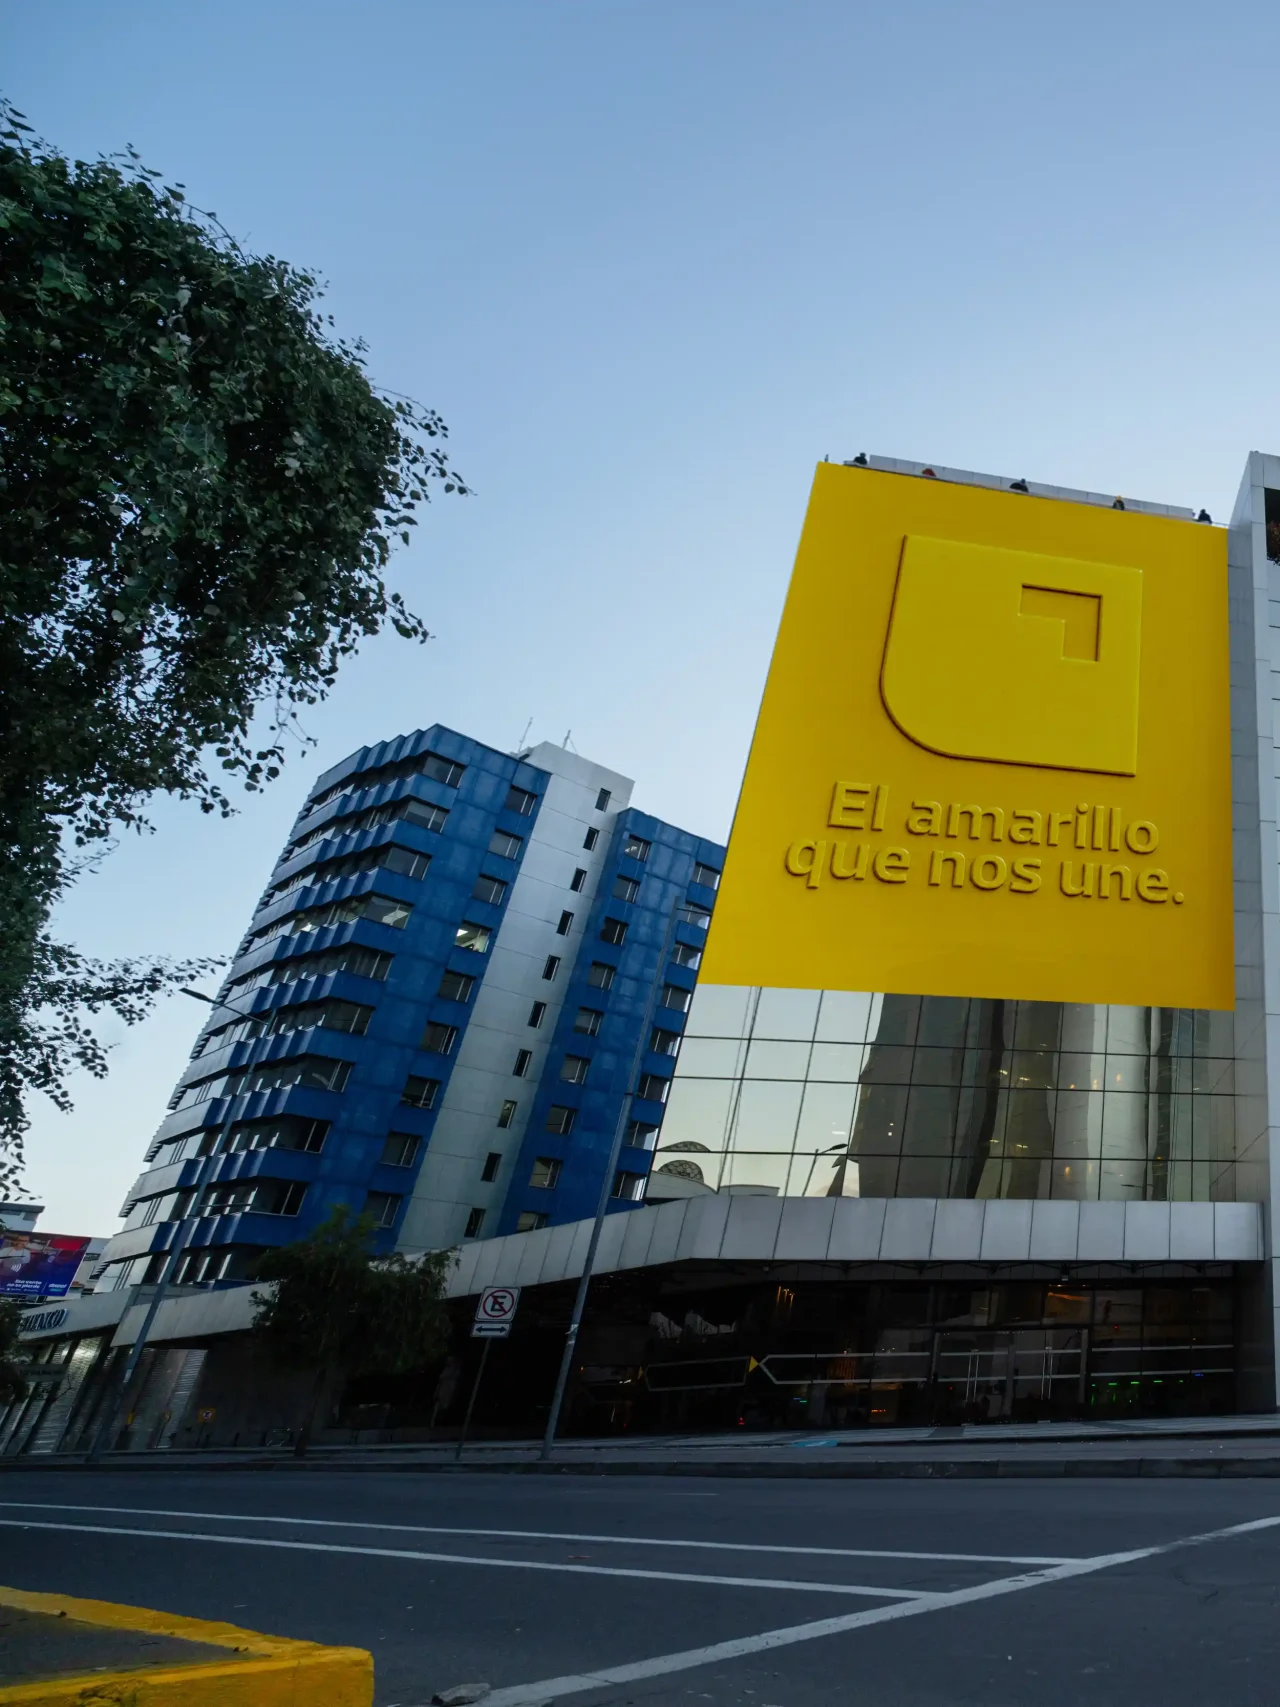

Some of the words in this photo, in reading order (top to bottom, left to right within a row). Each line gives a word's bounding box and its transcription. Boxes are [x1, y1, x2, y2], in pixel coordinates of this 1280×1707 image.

[827, 780, 890, 832] El
[905, 800, 1159, 855] amarillo
[785, 837, 912, 889] que
[928, 847, 1042, 893] nos
[1059, 859, 1185, 905] une.
[490, 1295, 507, 1312] E
